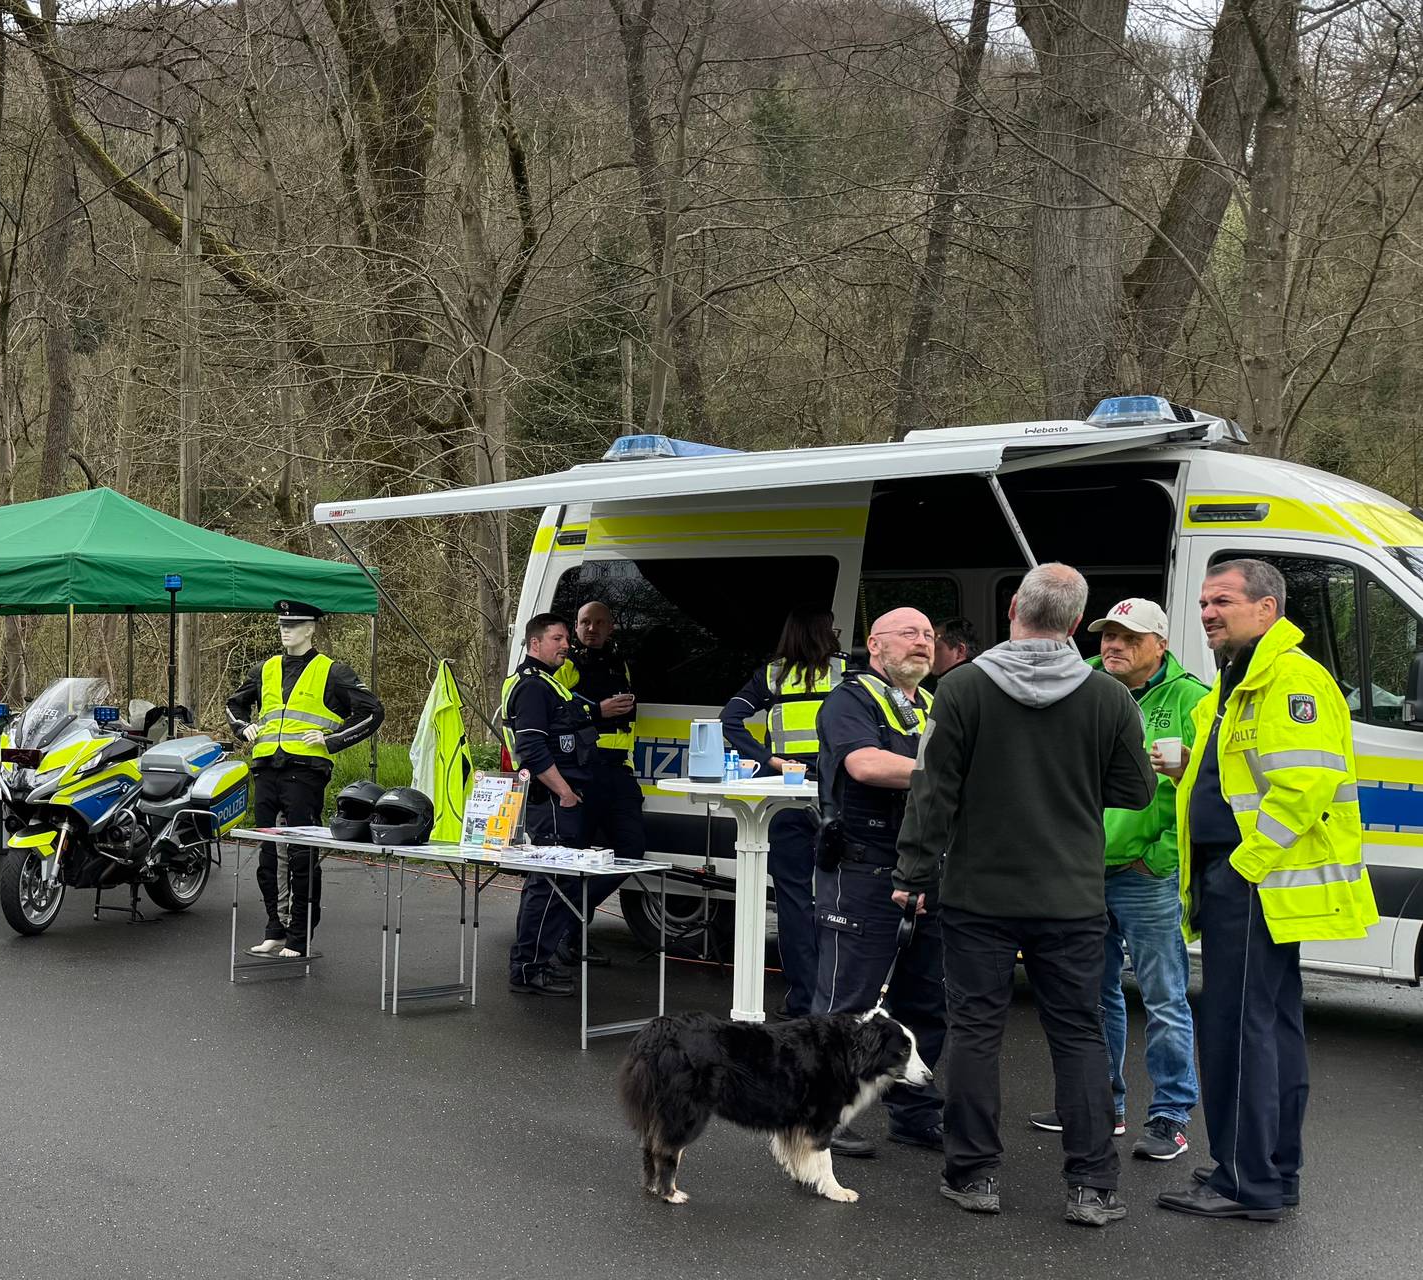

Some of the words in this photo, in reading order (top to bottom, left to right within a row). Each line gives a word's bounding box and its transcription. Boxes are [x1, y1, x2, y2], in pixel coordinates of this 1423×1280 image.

[1025, 426, 1069, 435] Webasto
[1114, 602, 1133, 616] NY
[217, 793, 246, 823] POLIZEI
[827, 914, 847, 925] POLIZEI
